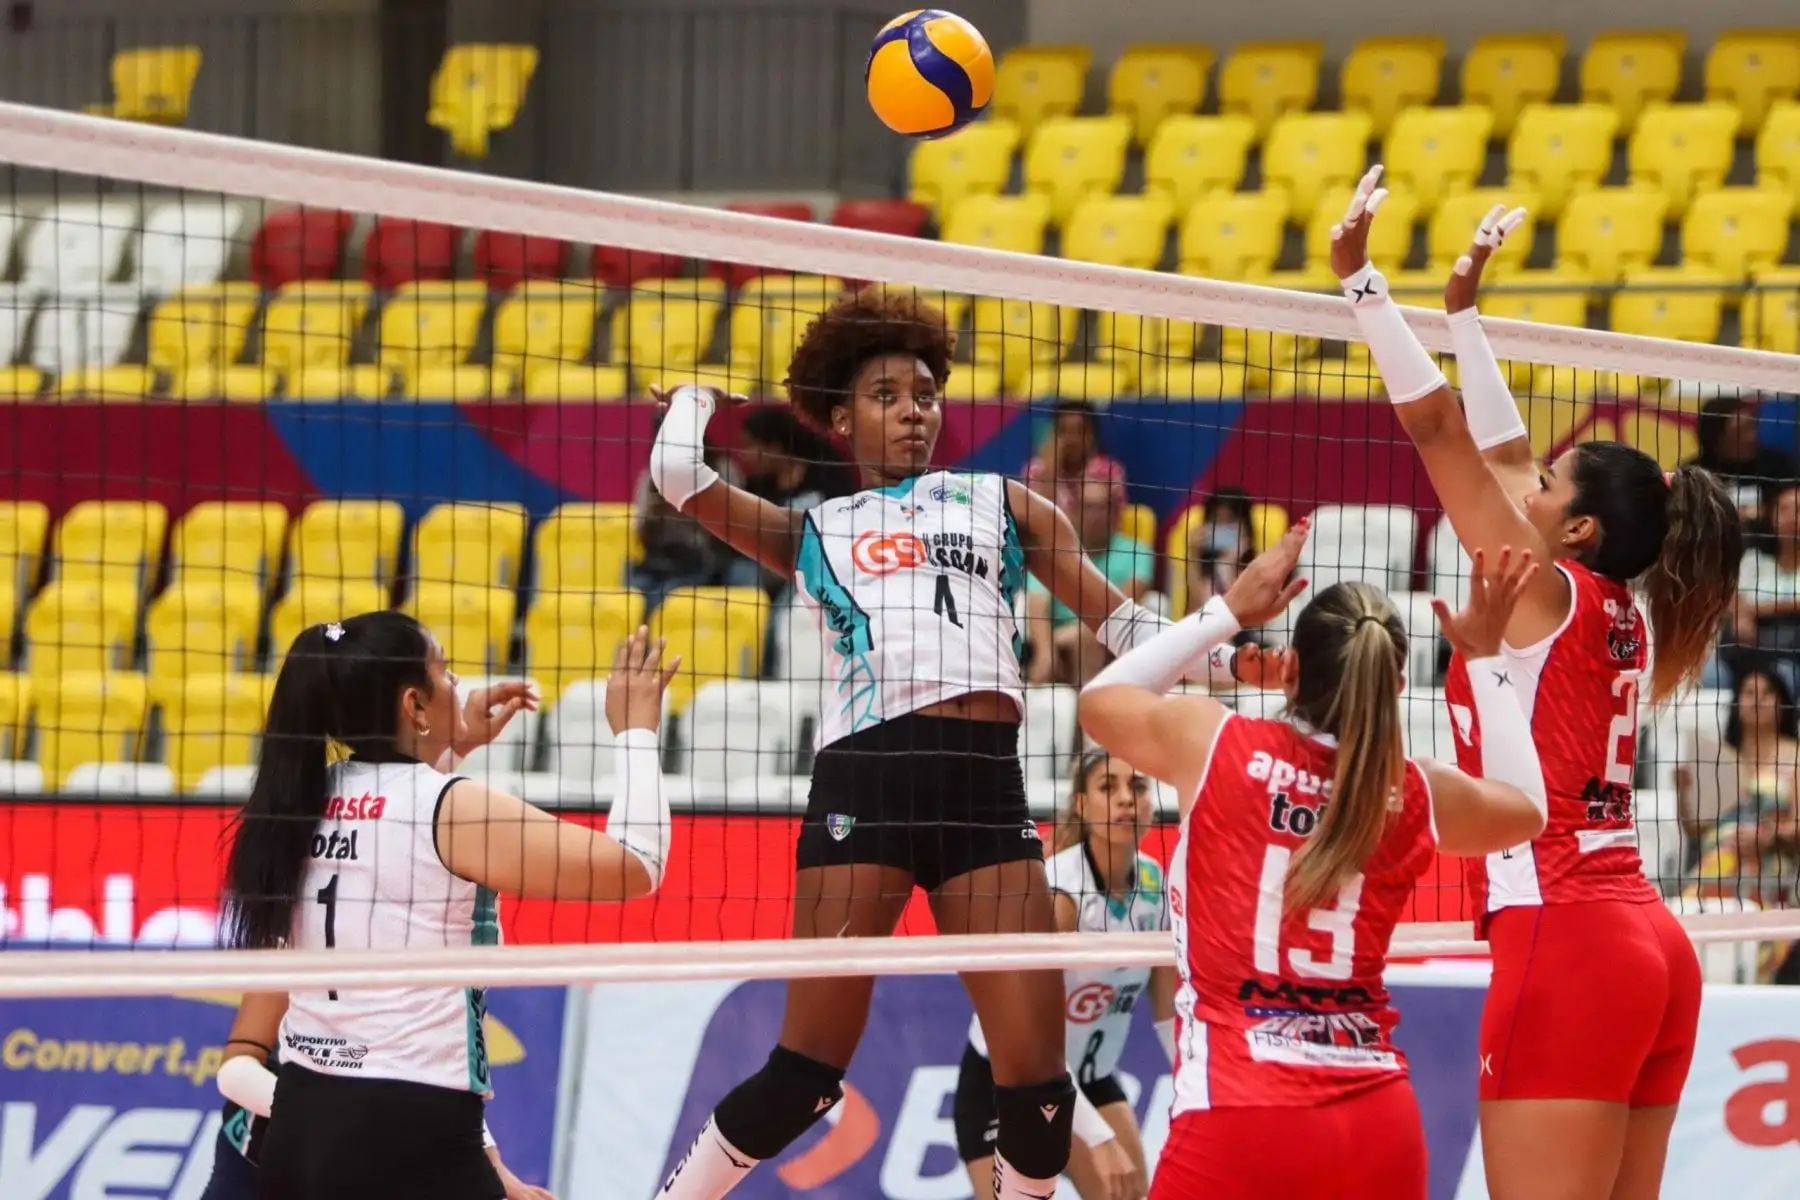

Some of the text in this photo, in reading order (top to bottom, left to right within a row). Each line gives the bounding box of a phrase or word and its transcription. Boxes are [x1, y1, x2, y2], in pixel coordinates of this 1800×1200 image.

[933, 532, 973, 550] GRUPO
[316, 873, 340, 1001] 1
[1253, 843, 1365, 981] 13
[1079, 1029, 1105, 1086] 8
